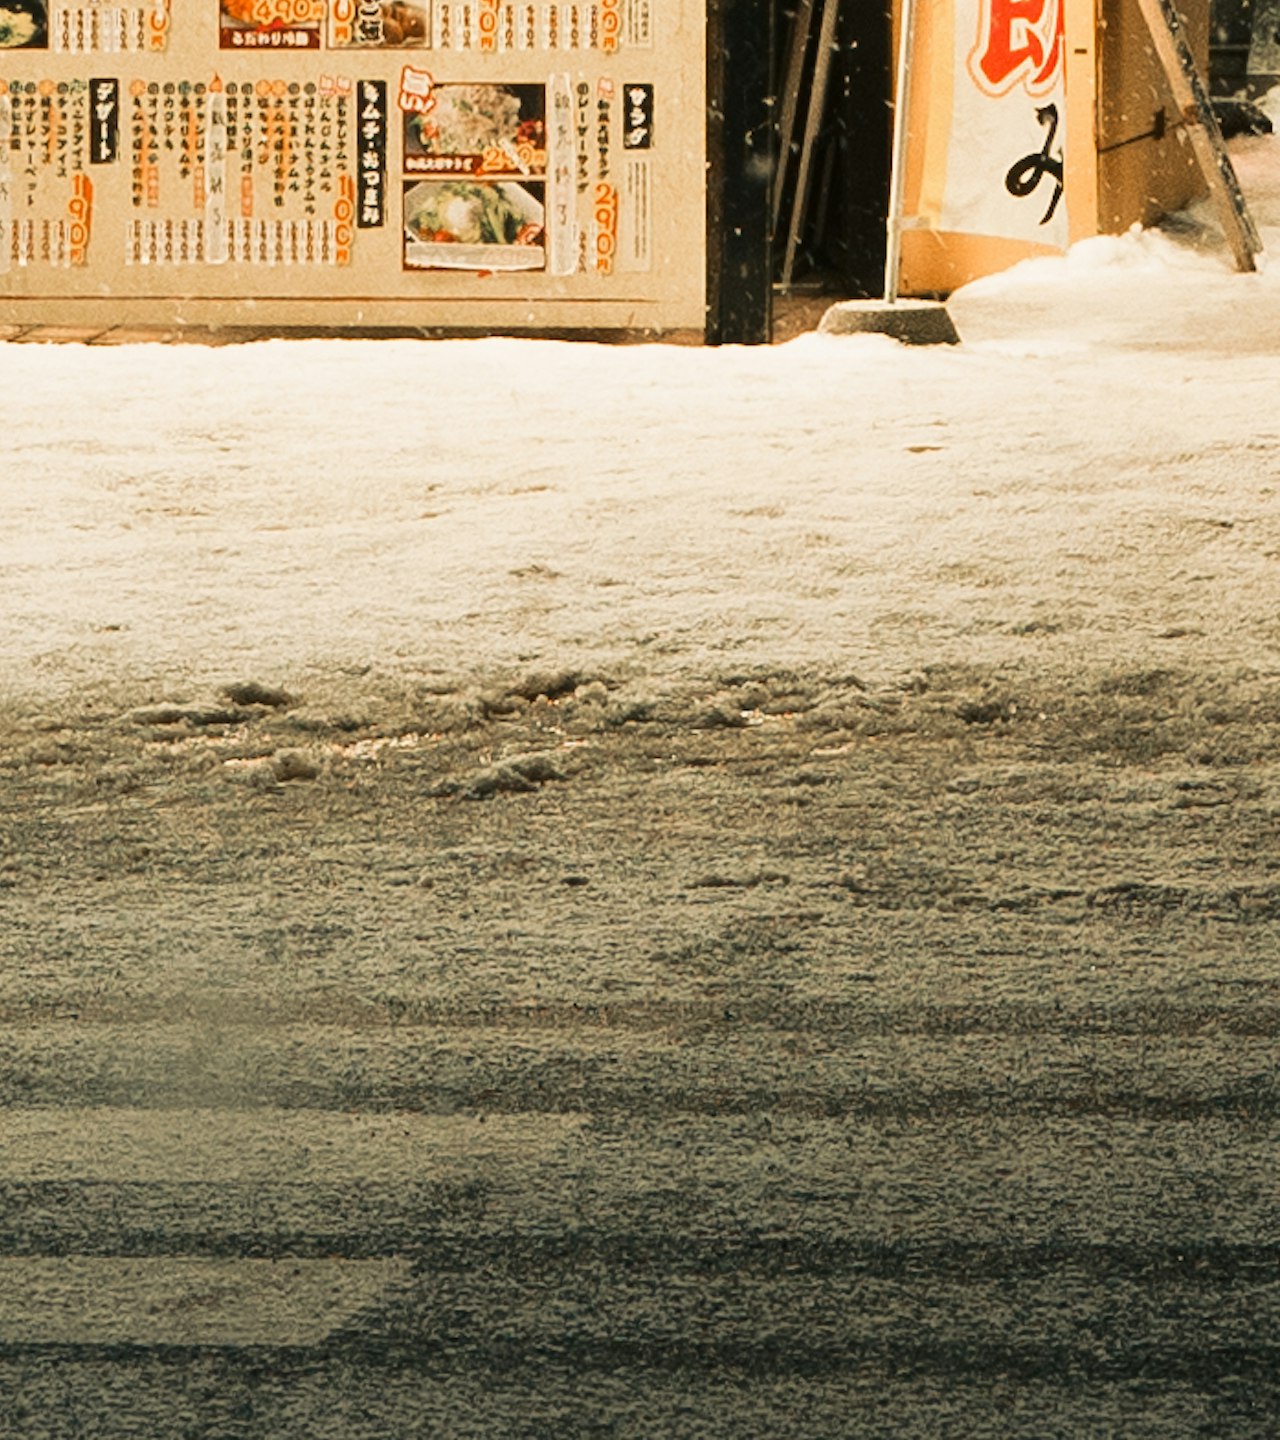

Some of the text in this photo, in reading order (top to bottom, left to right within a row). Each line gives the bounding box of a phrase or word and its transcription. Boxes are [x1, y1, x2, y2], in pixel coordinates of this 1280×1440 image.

[72, 96, 86, 171] バニラアイス
[95, 81, 116, 161] デザート
[626, 86, 649, 147] サラダ
